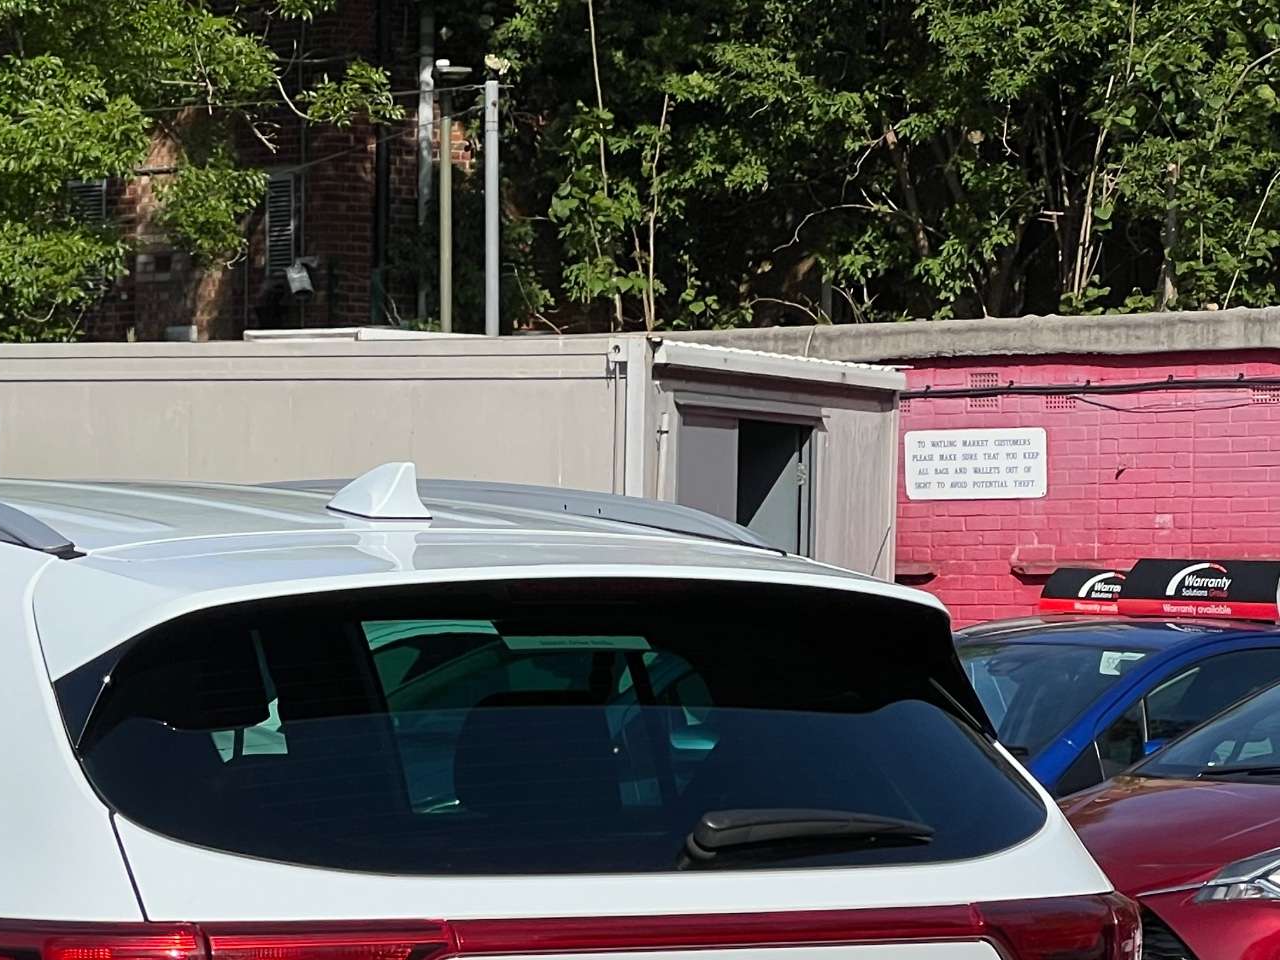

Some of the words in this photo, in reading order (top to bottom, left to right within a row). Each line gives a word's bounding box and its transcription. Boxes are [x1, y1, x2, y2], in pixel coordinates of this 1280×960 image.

[917, 440, 926, 448] TO
[961, 439, 989, 447] MARKET
[993, 438, 1031, 447] CUSTOMERS
[983, 452, 999, 460] THAT
[1005, 452, 1017, 460] YOU
[973, 466, 1000, 474] WALLETS
[1005, 466, 1018, 474] OUT
[937, 481, 946, 489] TO
[950, 480, 968, 488] AVOID
[973, 480, 1009, 488] POTENTIAL
[1013, 479, 1035, 487] THEFT
[1093, 581, 1121, 592] Warra
[1184, 574, 1232, 591] Warranty
[1182, 587, 1208, 597] Solutions
[1162, 603, 1197, 615] Warranty
[1197, 604, 1232, 615] available
